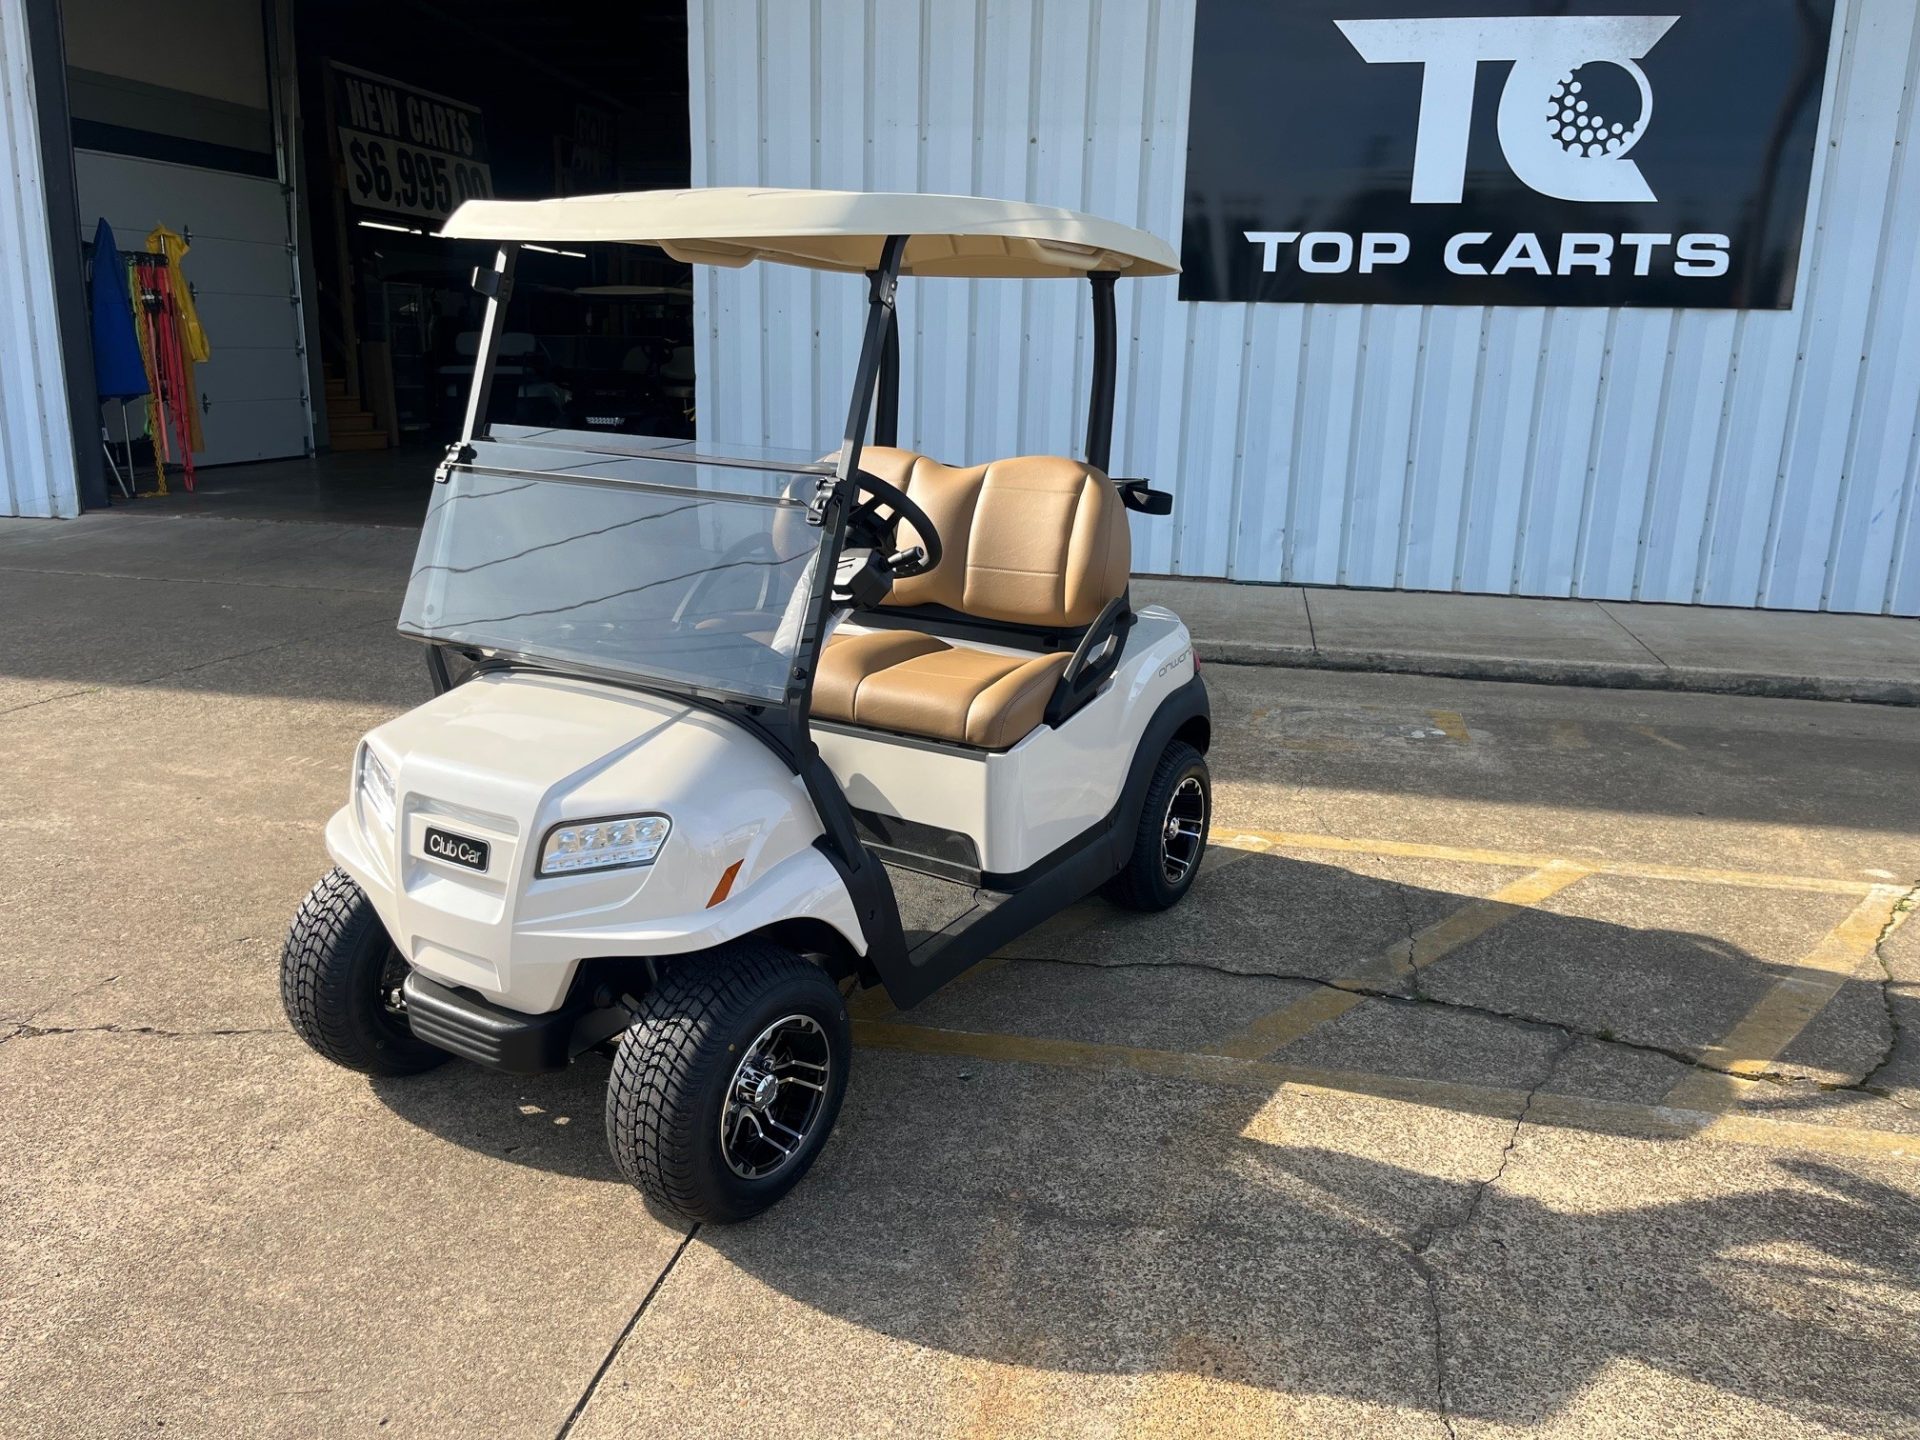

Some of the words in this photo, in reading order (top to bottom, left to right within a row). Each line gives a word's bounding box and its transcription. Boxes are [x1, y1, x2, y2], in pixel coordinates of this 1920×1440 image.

[346, 79, 400, 136] NEW
[406, 96, 474, 156] CARTS
[350, 138, 487, 213] $6,99500
[1243, 231, 1410, 273] TOP
[1443, 232, 1730, 277] CARTS
[430, 834, 457, 857] Club
[458, 843, 481, 864] Car
